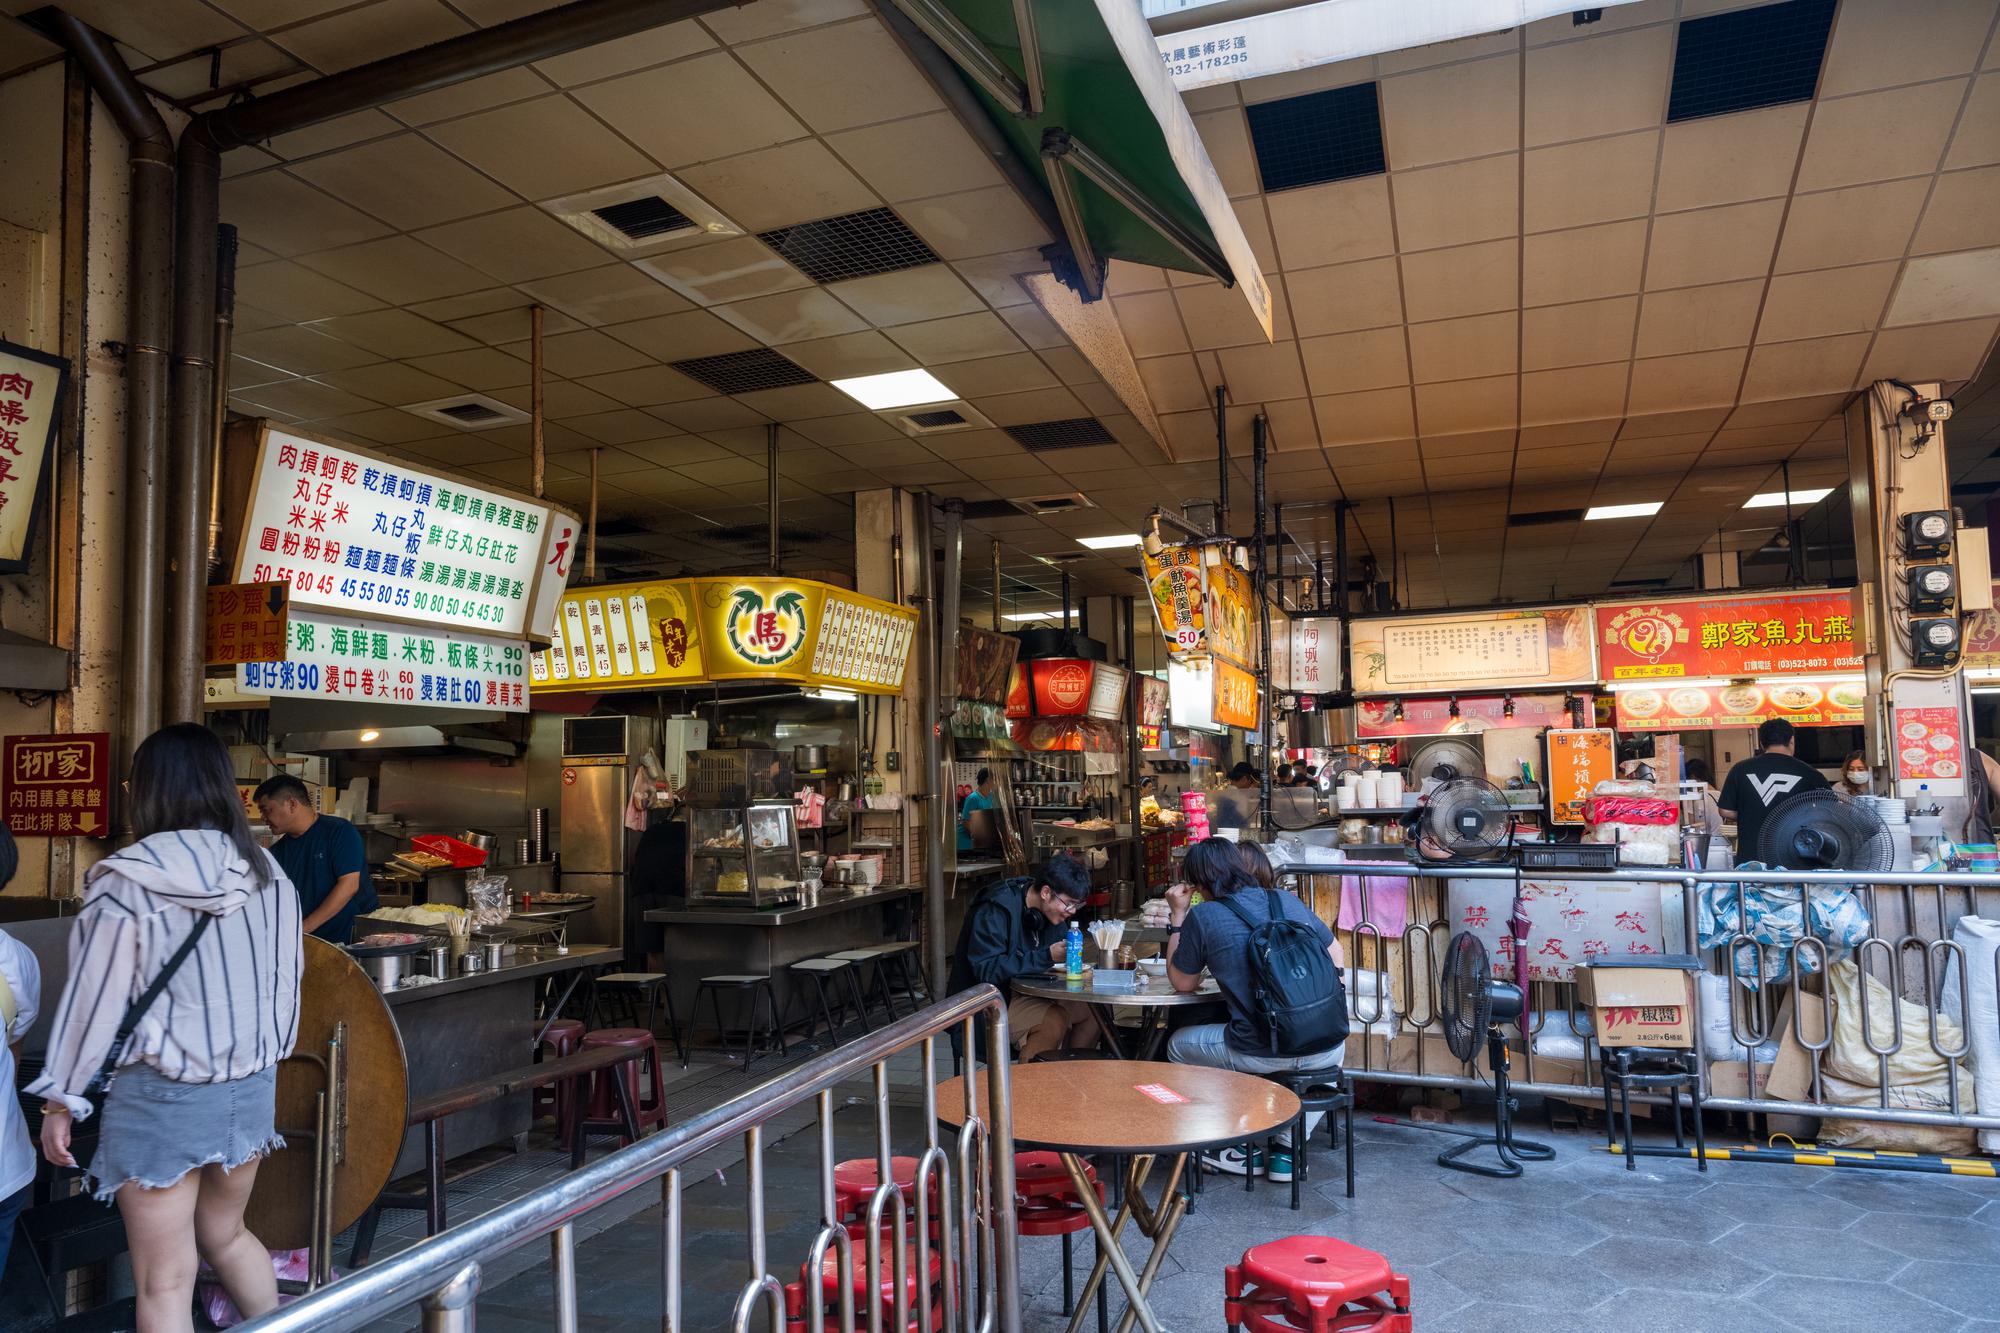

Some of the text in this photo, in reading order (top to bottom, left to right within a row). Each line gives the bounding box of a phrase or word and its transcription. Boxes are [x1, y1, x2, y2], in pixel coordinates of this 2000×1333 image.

[253, 564, 271, 583] 50
[296, 571, 314, 591] 80
[317, 574, 334, 595] 45
[340, 578, 358, 598] 45
[359, 581, 376, 601] 55
[377, 584, 393, 604] 80
[394, 588, 411, 607] 55
[413, 591, 428, 610] 90
[430, 594, 444, 613] 80
[445, 597, 459, 616] 50
[461, 600, 475, 618] 45
[476, 603, 489, 621] 45
[491, 606, 504, 624] 30
[632, 602, 650, 652] 小菜
[750, 612, 786, 651] 馬
[567, 606, 588, 672] 乾麵 45
[588, 604, 609, 670] 燙青菜 45
[1178, 631, 1196, 644] 50
[483, 644, 522, 661] 小 90
[1304, 629, 1319, 681] 阿城號
[483, 660, 522, 677] 大 110
[534, 664, 545, 674] 55
[555, 664, 567, 673] 55
[1778, 658, 1827, 669] (03)523-8073
[378, 669, 413, 683] 小 60
[378, 684, 413, 701] 大 110
[486, 680, 522, 707] 燙青菜
[19, 747, 87, 778] 柳家
[10, 813, 72, 831] 在此排隊
